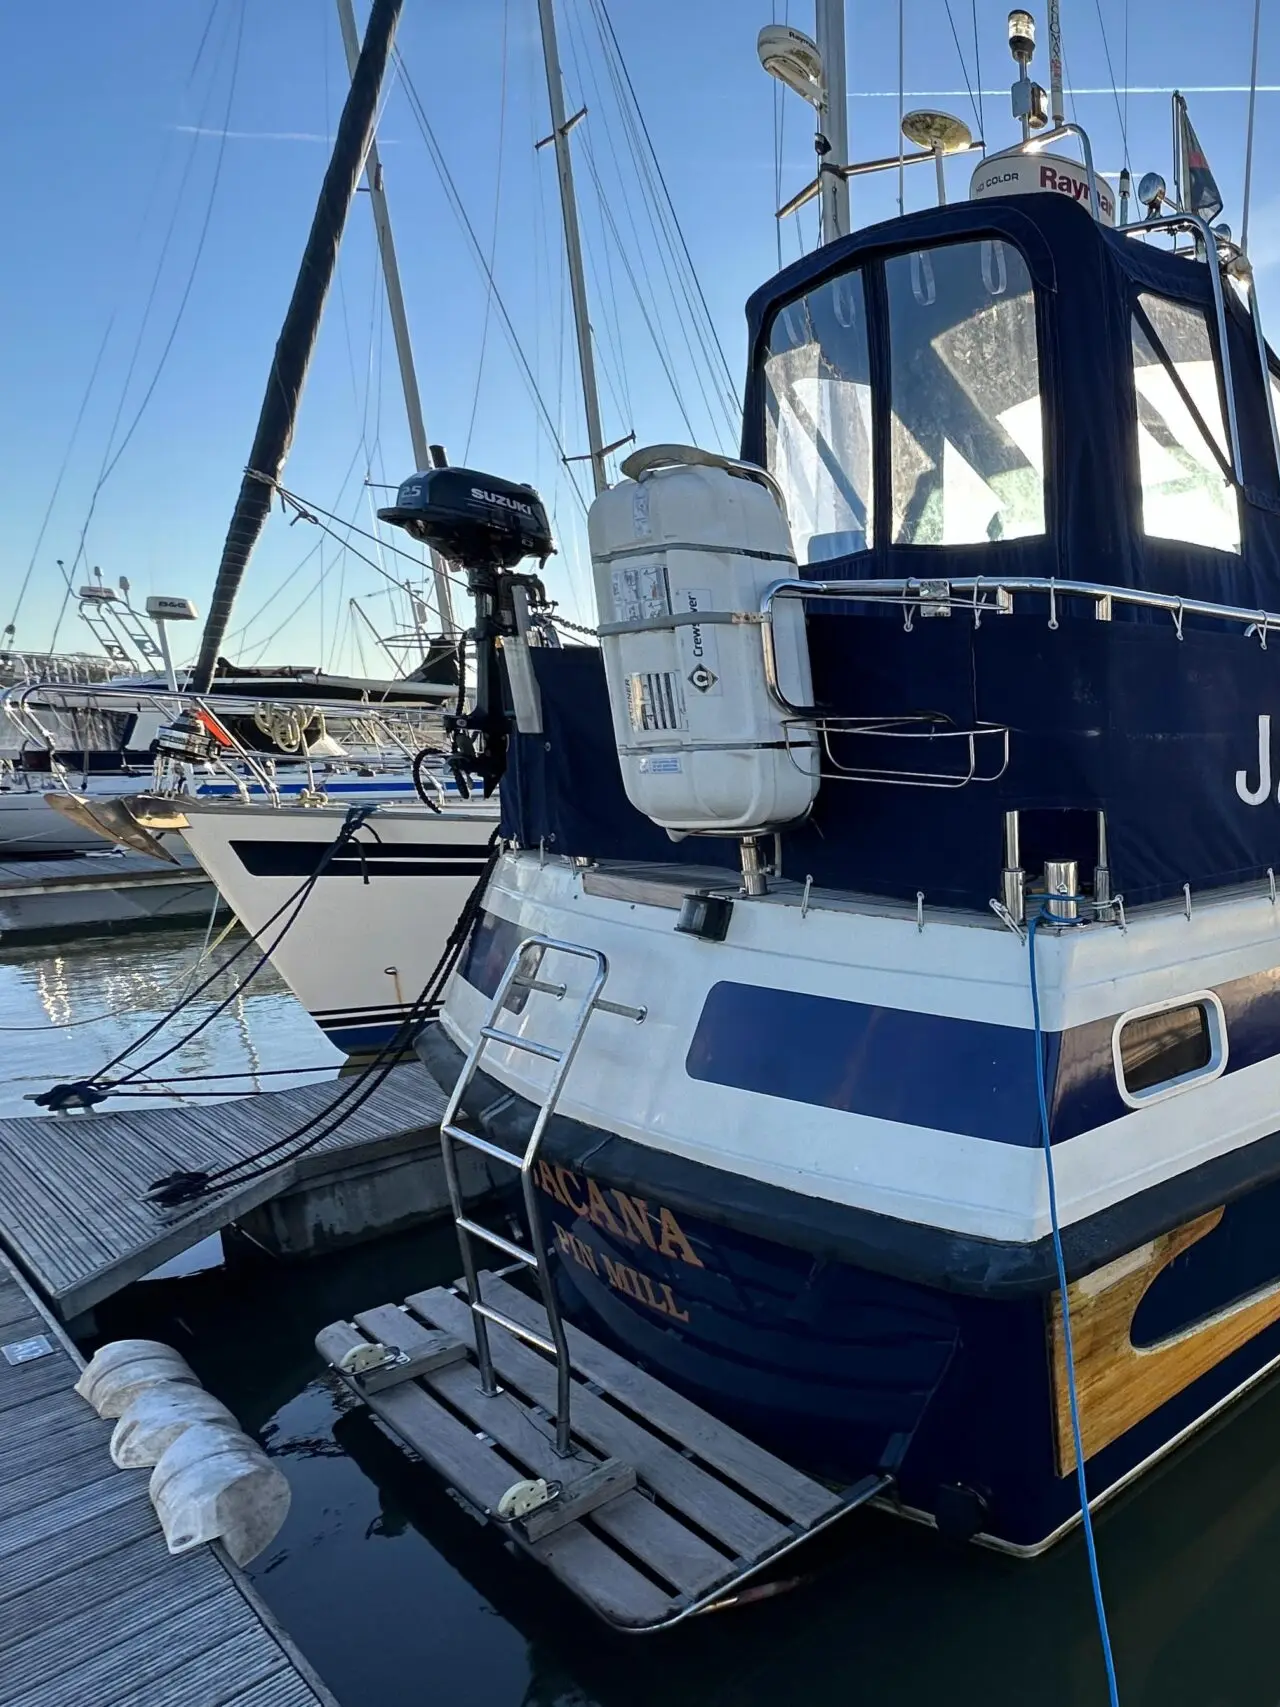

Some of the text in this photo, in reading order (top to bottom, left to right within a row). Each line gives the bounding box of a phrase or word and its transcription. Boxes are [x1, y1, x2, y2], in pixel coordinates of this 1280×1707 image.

[986, 172, 1020, 188] COLOR
[470, 487, 533, 516] SUZUKI
[687, 594, 704, 657] Crewver
[600, 1253, 690, 1324] MILL
